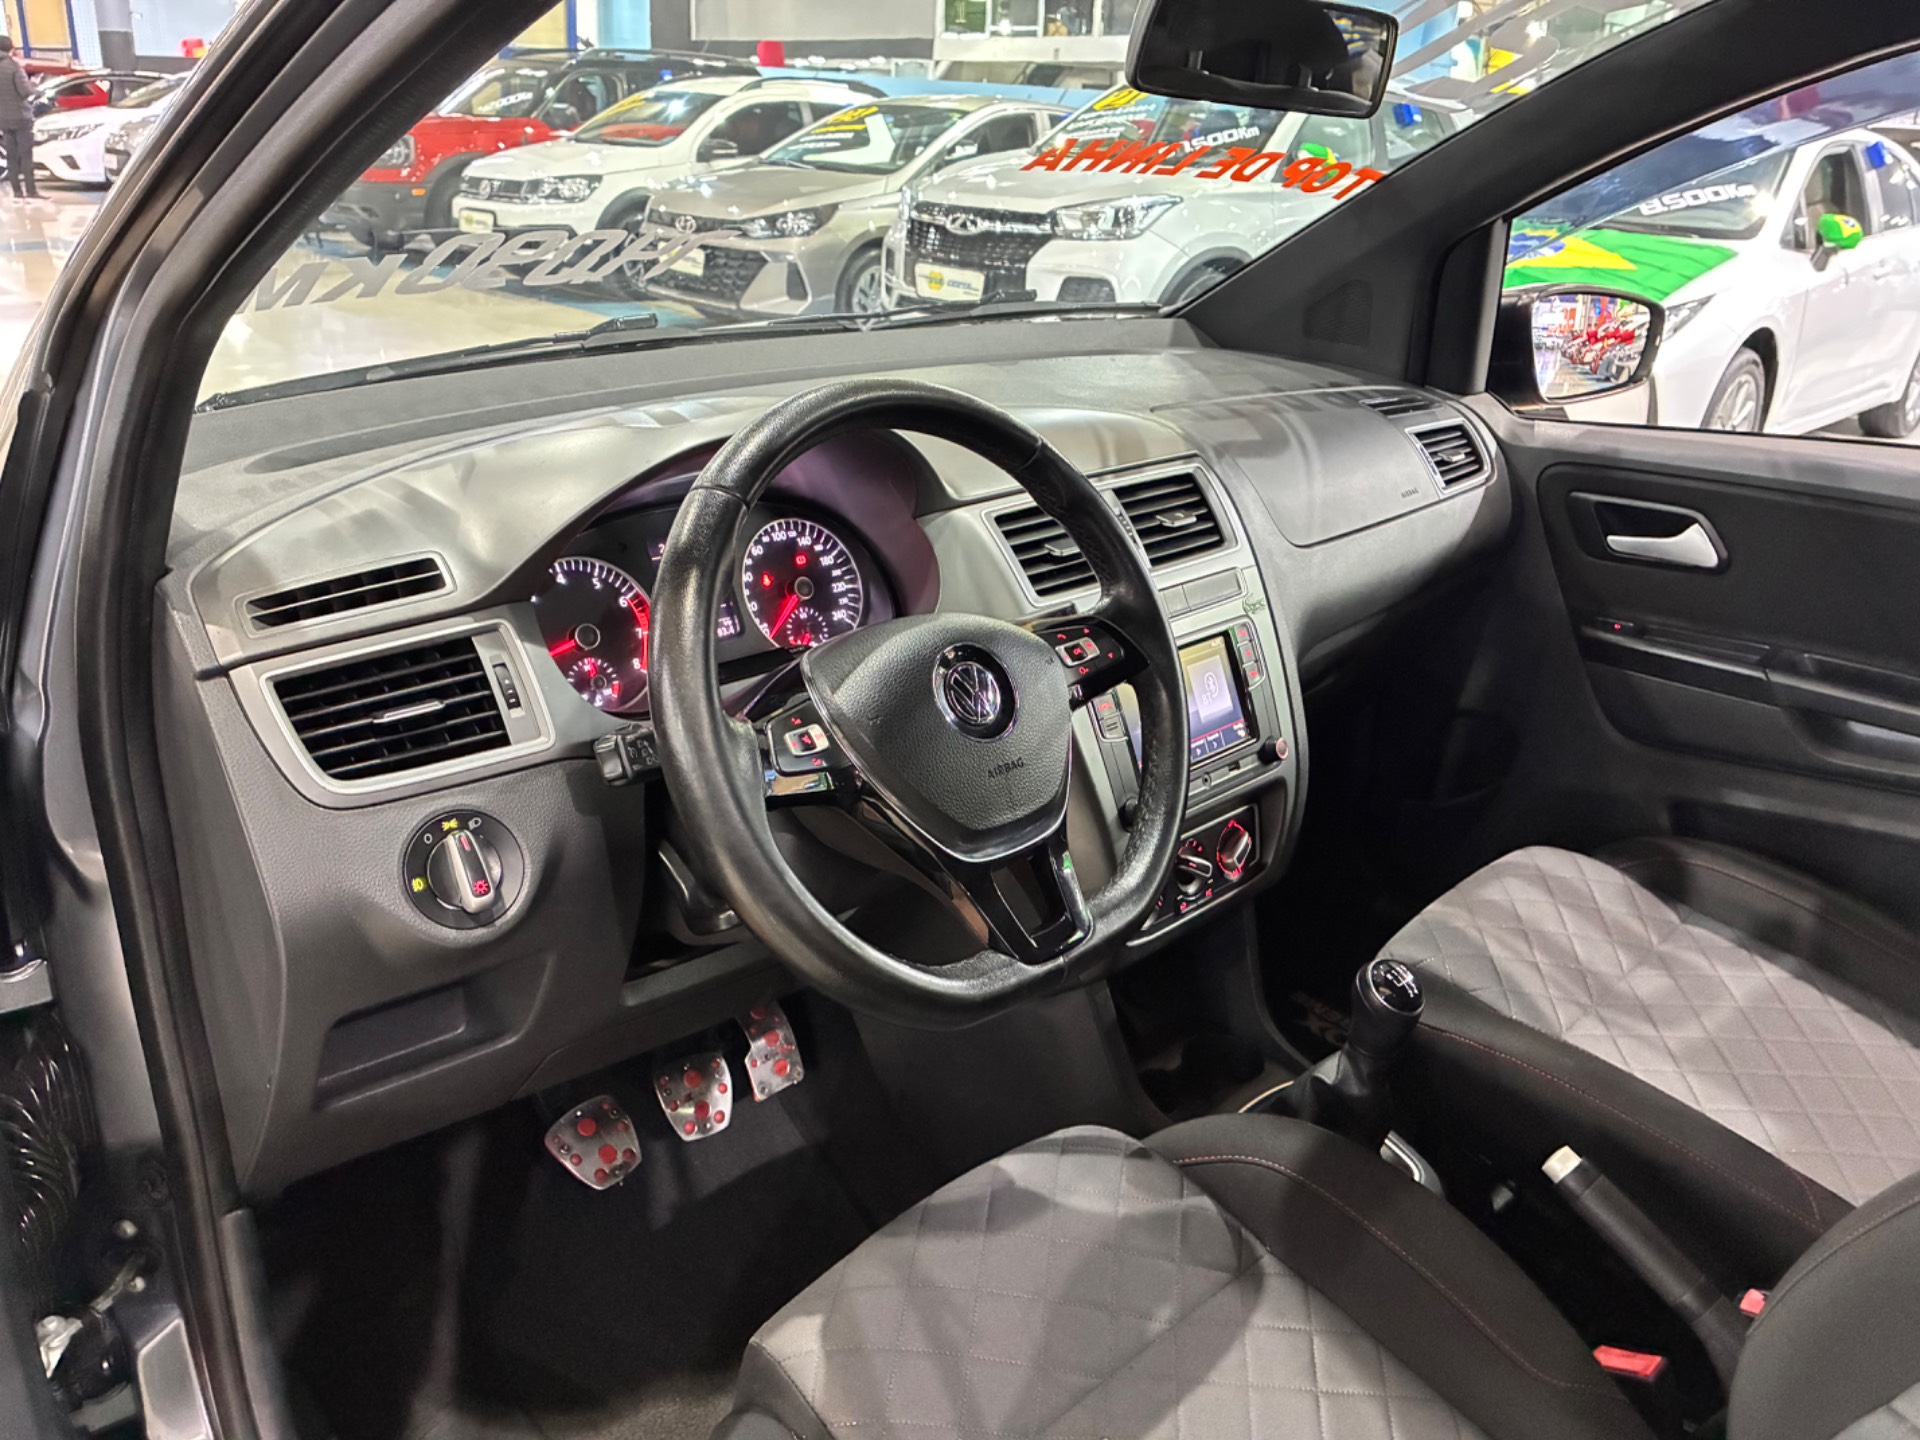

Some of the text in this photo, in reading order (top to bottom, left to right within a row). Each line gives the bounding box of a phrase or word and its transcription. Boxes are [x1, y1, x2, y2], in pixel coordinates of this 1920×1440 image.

[592, 577, 601, 590] 5
[619, 596, 629, 607] 6
[635, 628, 643, 639] 7
[632, 658, 641, 669] 8
[987, 756, 1025, 779] AIRBAG
